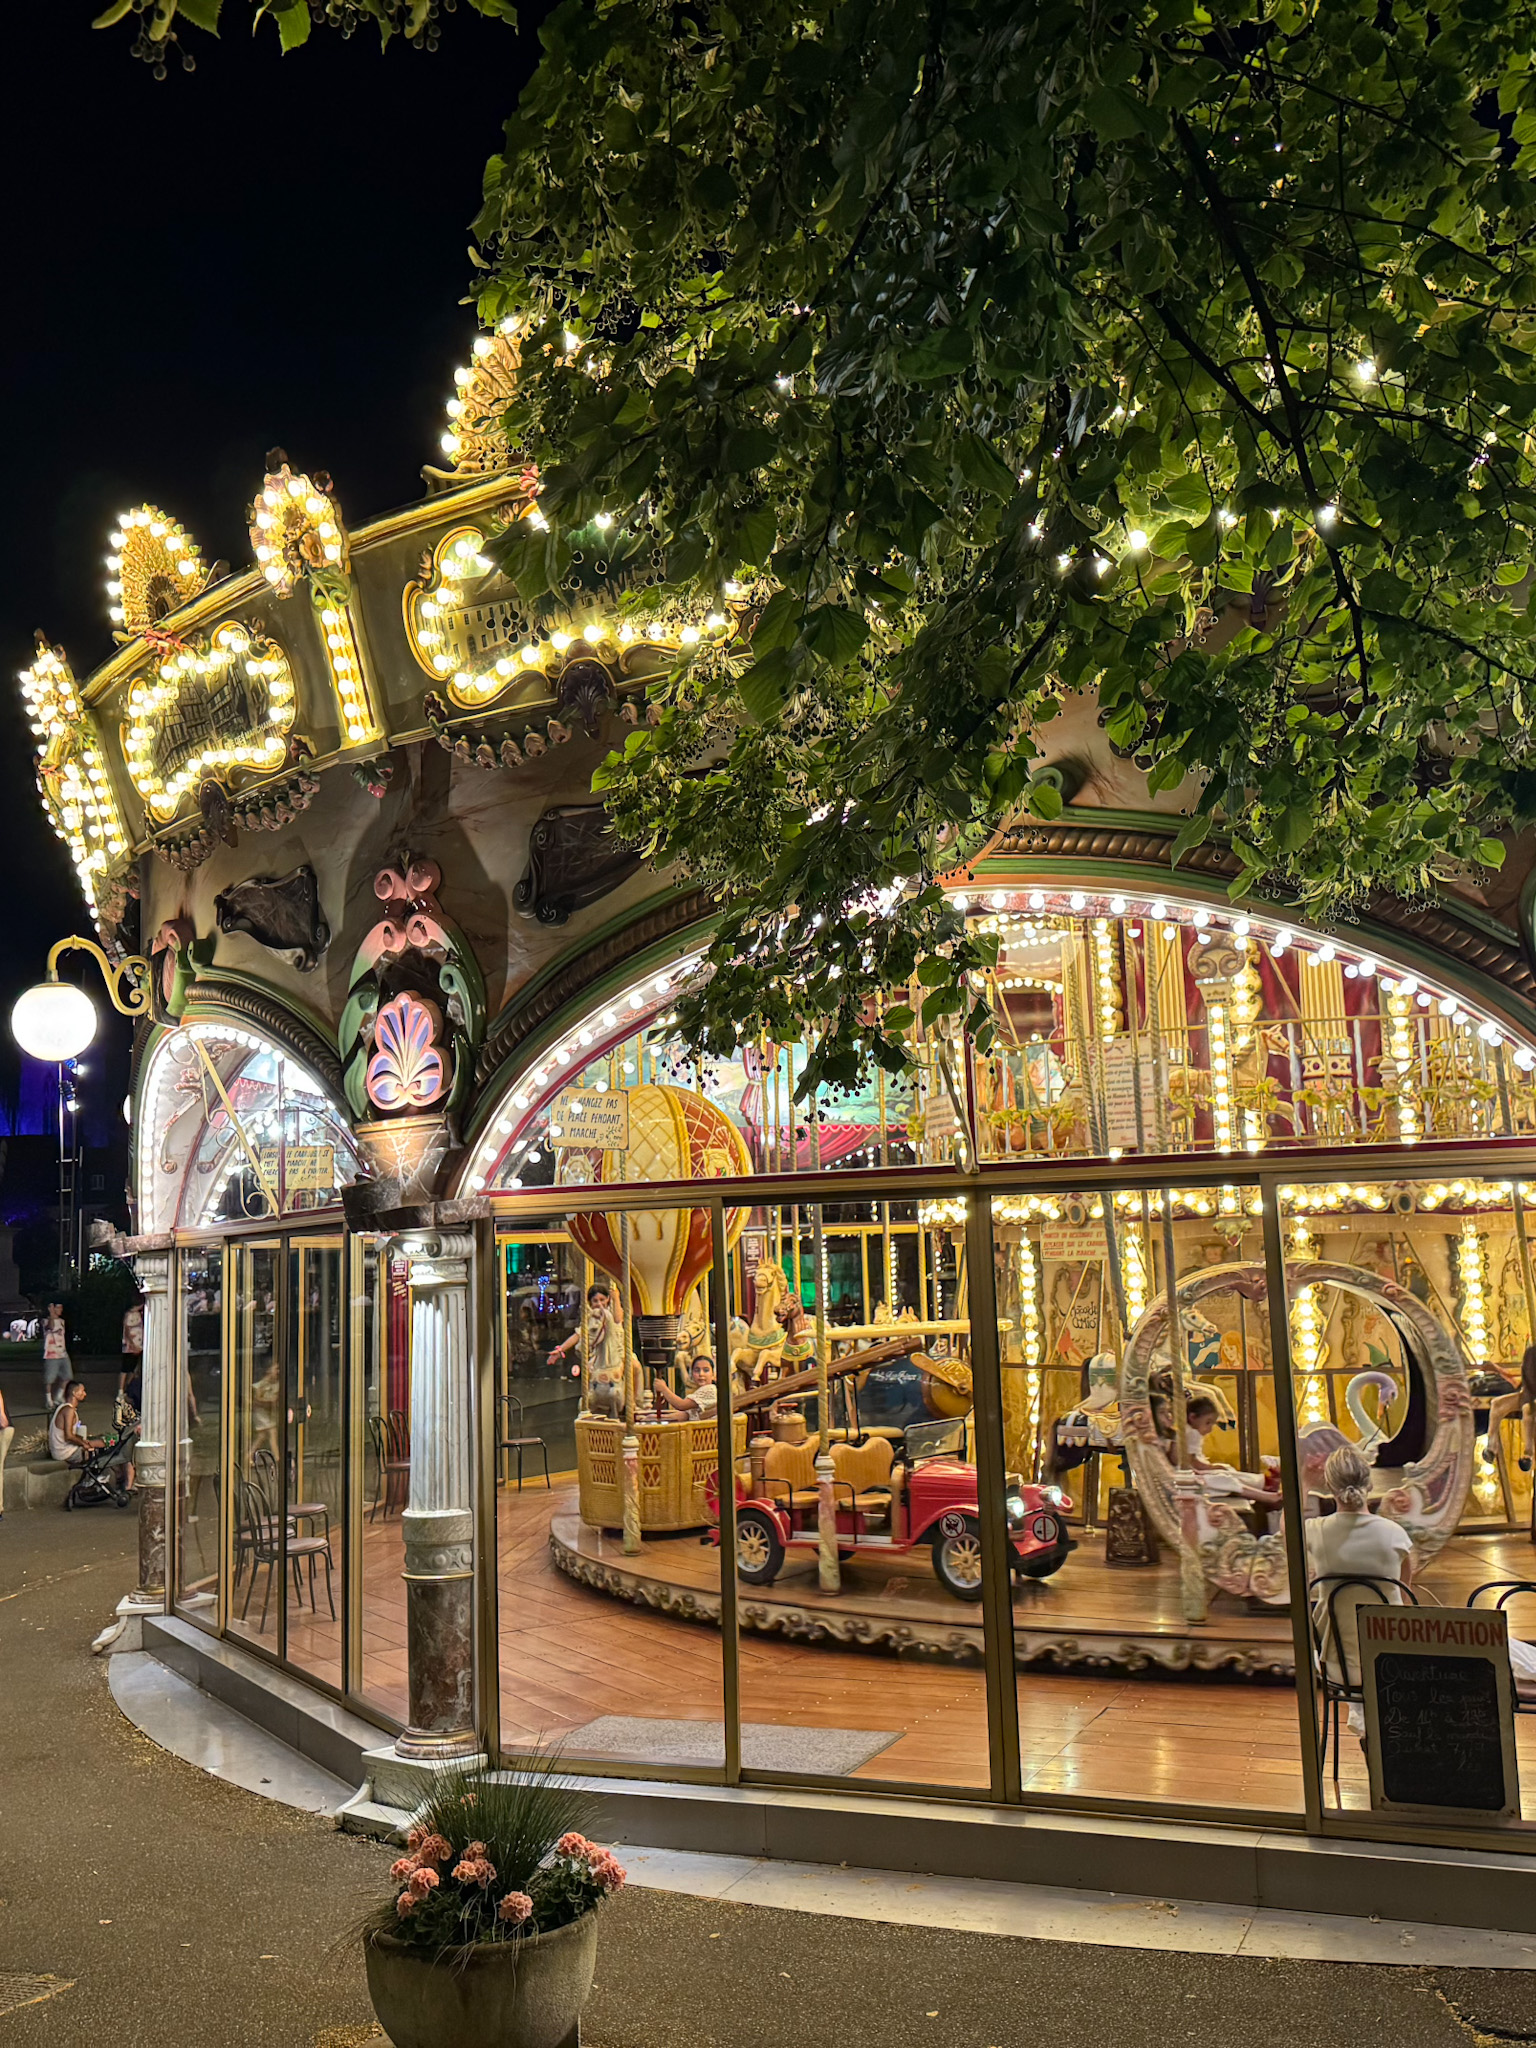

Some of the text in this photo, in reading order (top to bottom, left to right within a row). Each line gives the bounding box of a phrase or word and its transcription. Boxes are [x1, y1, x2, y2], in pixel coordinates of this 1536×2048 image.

[561, 1095, 569, 1106] NE
[606, 1098, 618, 1109] PAS
[557, 1110, 621, 1125] DE PLACE PENDANT
[570, 1127, 597, 1138] MARCHE
[1366, 1615, 1505, 1647] INFORMATION
[1384, 1706, 1410, 1724] De
